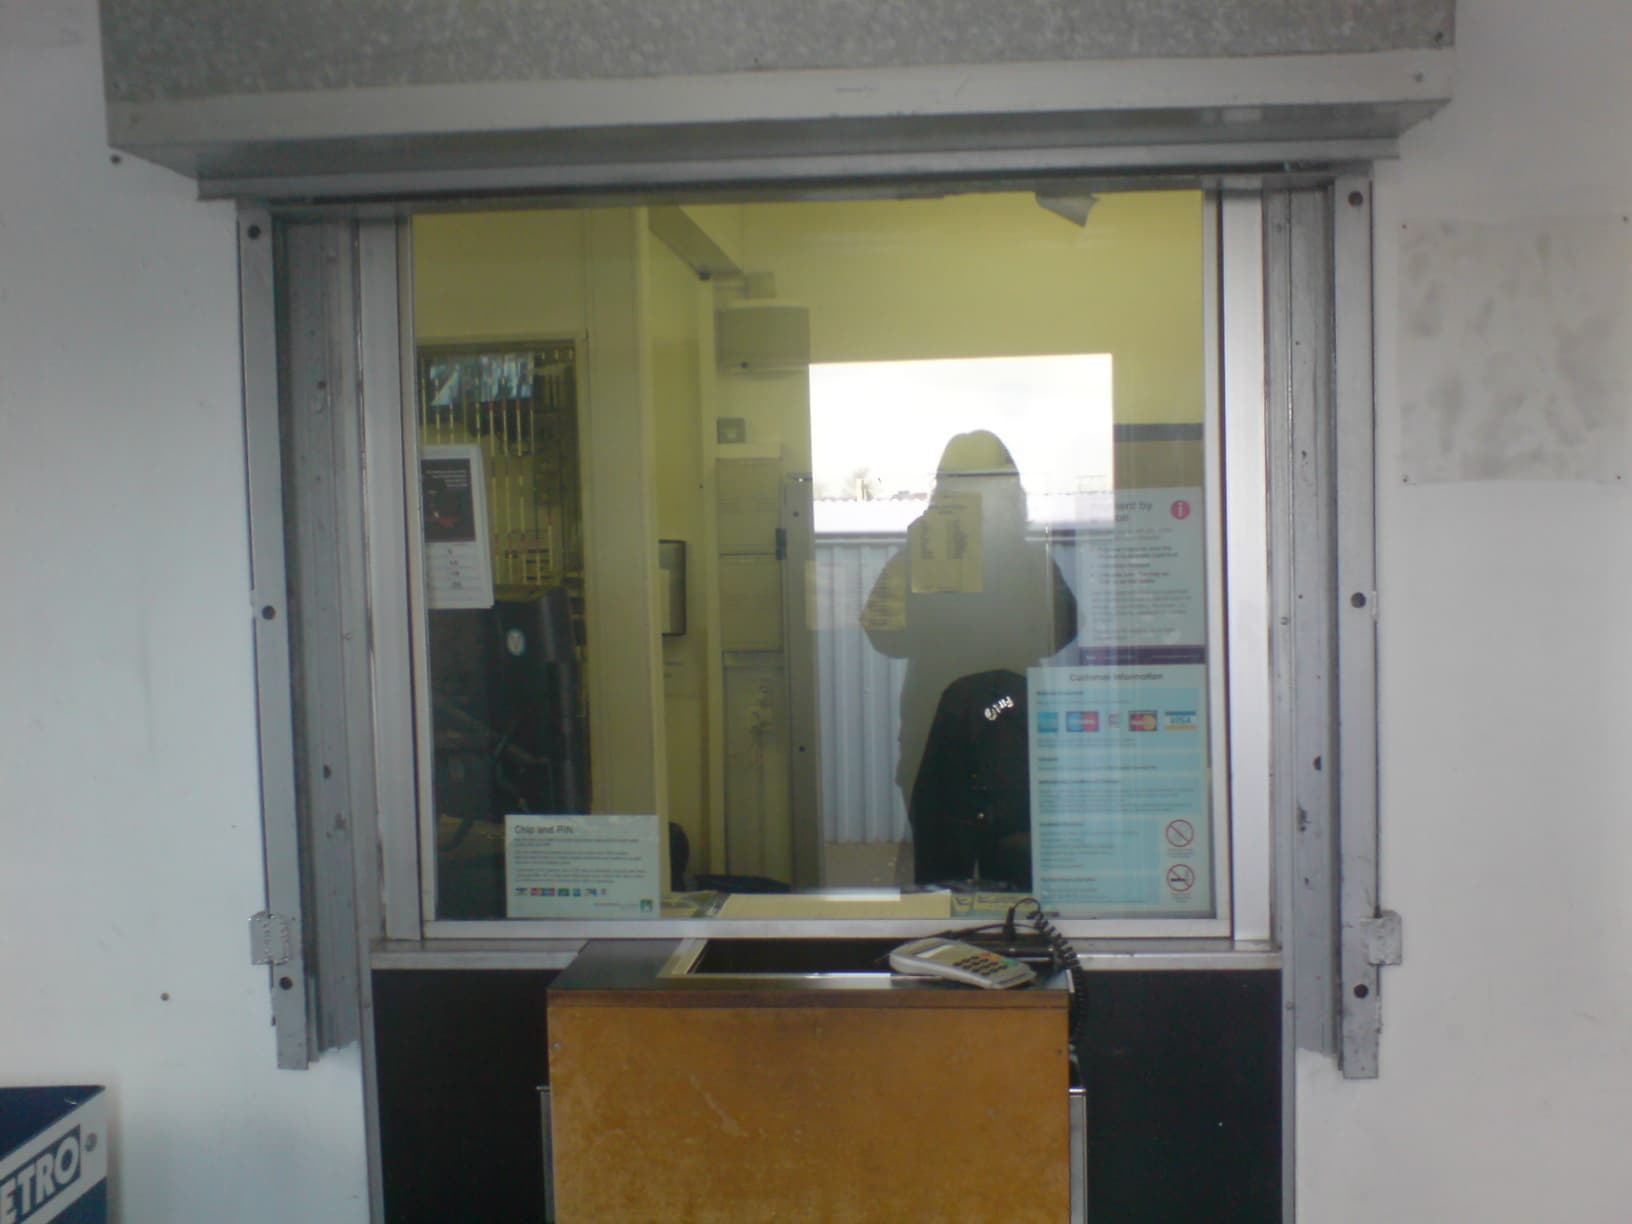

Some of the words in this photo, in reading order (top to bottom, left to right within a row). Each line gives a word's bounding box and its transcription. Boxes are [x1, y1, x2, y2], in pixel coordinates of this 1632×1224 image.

[514, 825, 534, 835] Chip
[537, 825, 554, 834] and
[0, 1136, 80, 1224] ETRO
